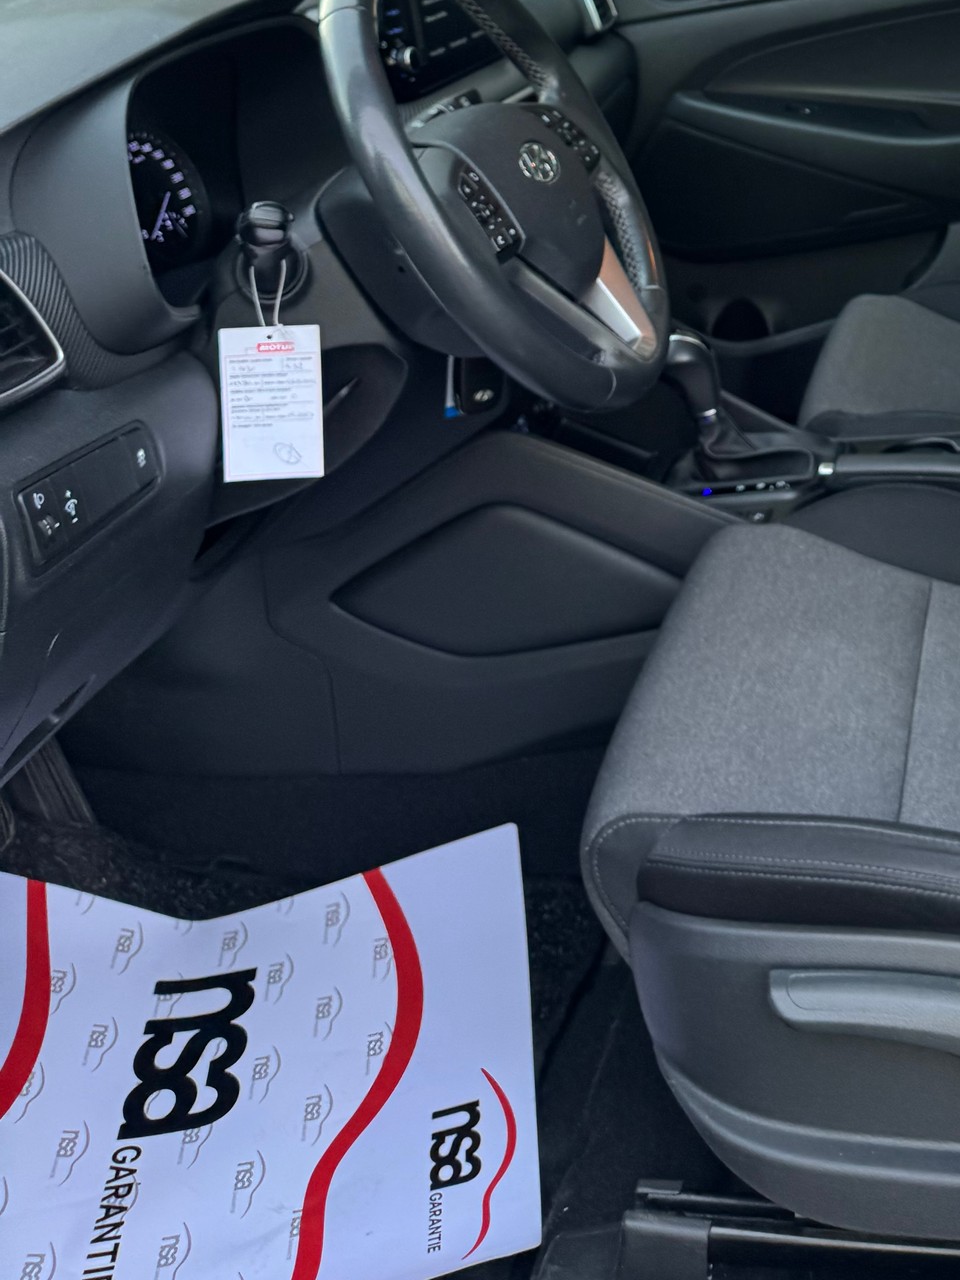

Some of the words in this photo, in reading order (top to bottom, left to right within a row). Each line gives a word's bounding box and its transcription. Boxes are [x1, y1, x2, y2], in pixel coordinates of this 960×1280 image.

[117, 967, 258, 1140] nsa
[57, 1130, 79, 1157] nsa
[430, 1099, 481, 1191] nsa
[235, 1161, 254, 1190] nsa
[427, 1192, 443, 1254] GARANTIE
[157, 1234, 180, 1268] nsa
